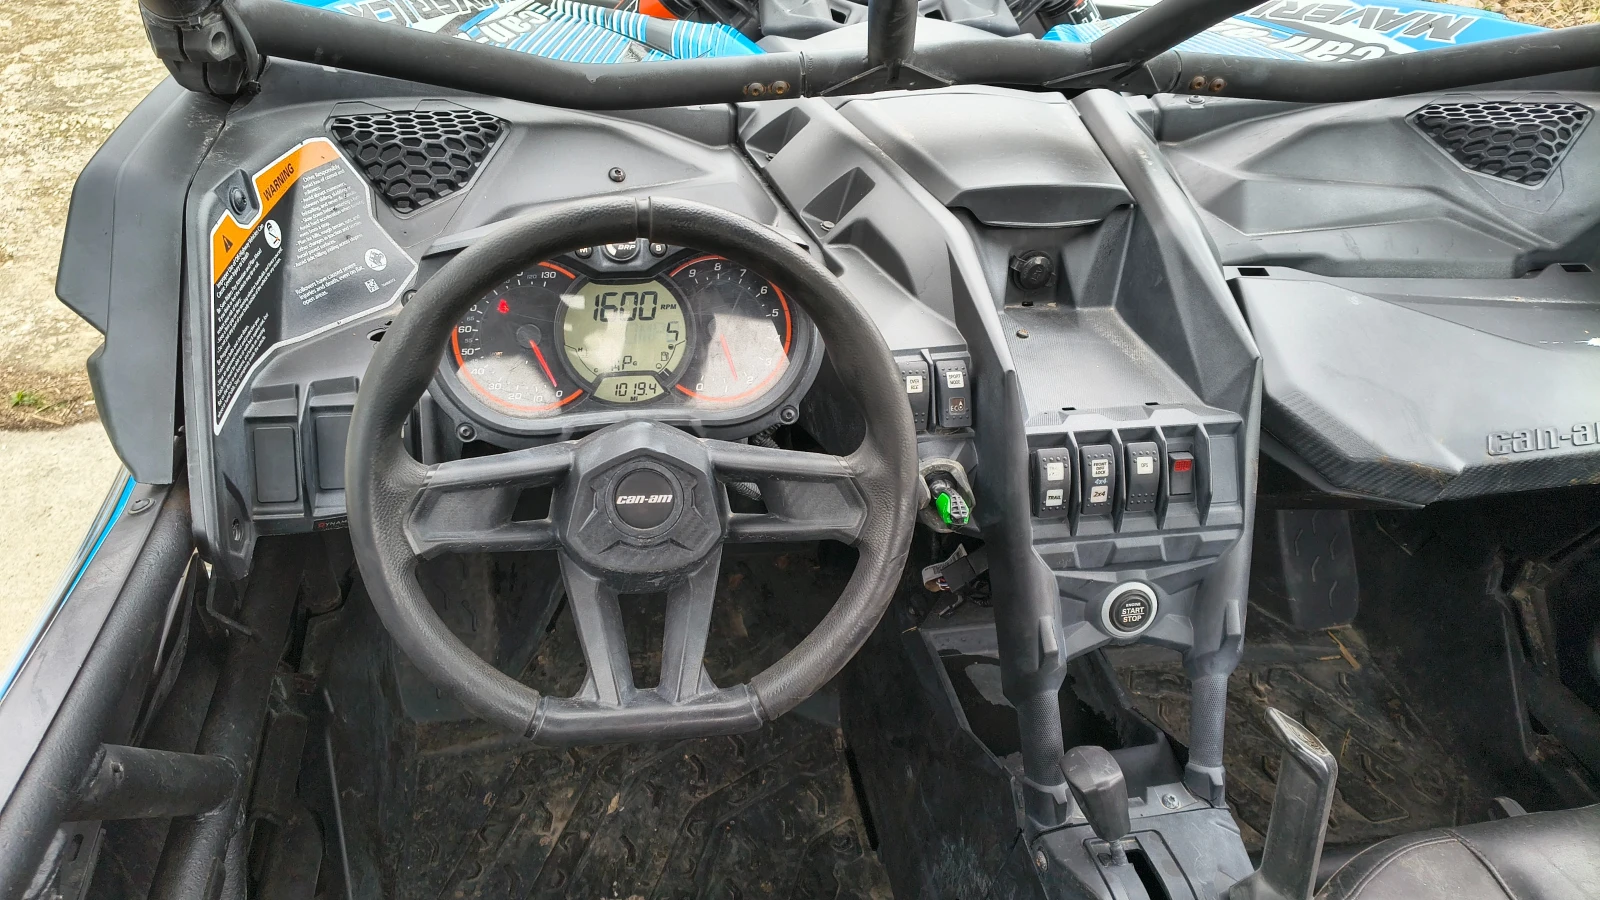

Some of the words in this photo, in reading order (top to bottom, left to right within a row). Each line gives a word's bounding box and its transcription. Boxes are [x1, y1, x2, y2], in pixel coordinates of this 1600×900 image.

[263, 163, 294, 201] WARNING
[714, 263, 721, 271] 8
[689, 269, 696, 277] 9
[593, 291, 658, 322] 1600
[772, 309, 779, 317] 5
[696, 383, 704, 391] 0
[1487, 421, 1600, 457] can-a
[616, 494, 673, 505] can-am
